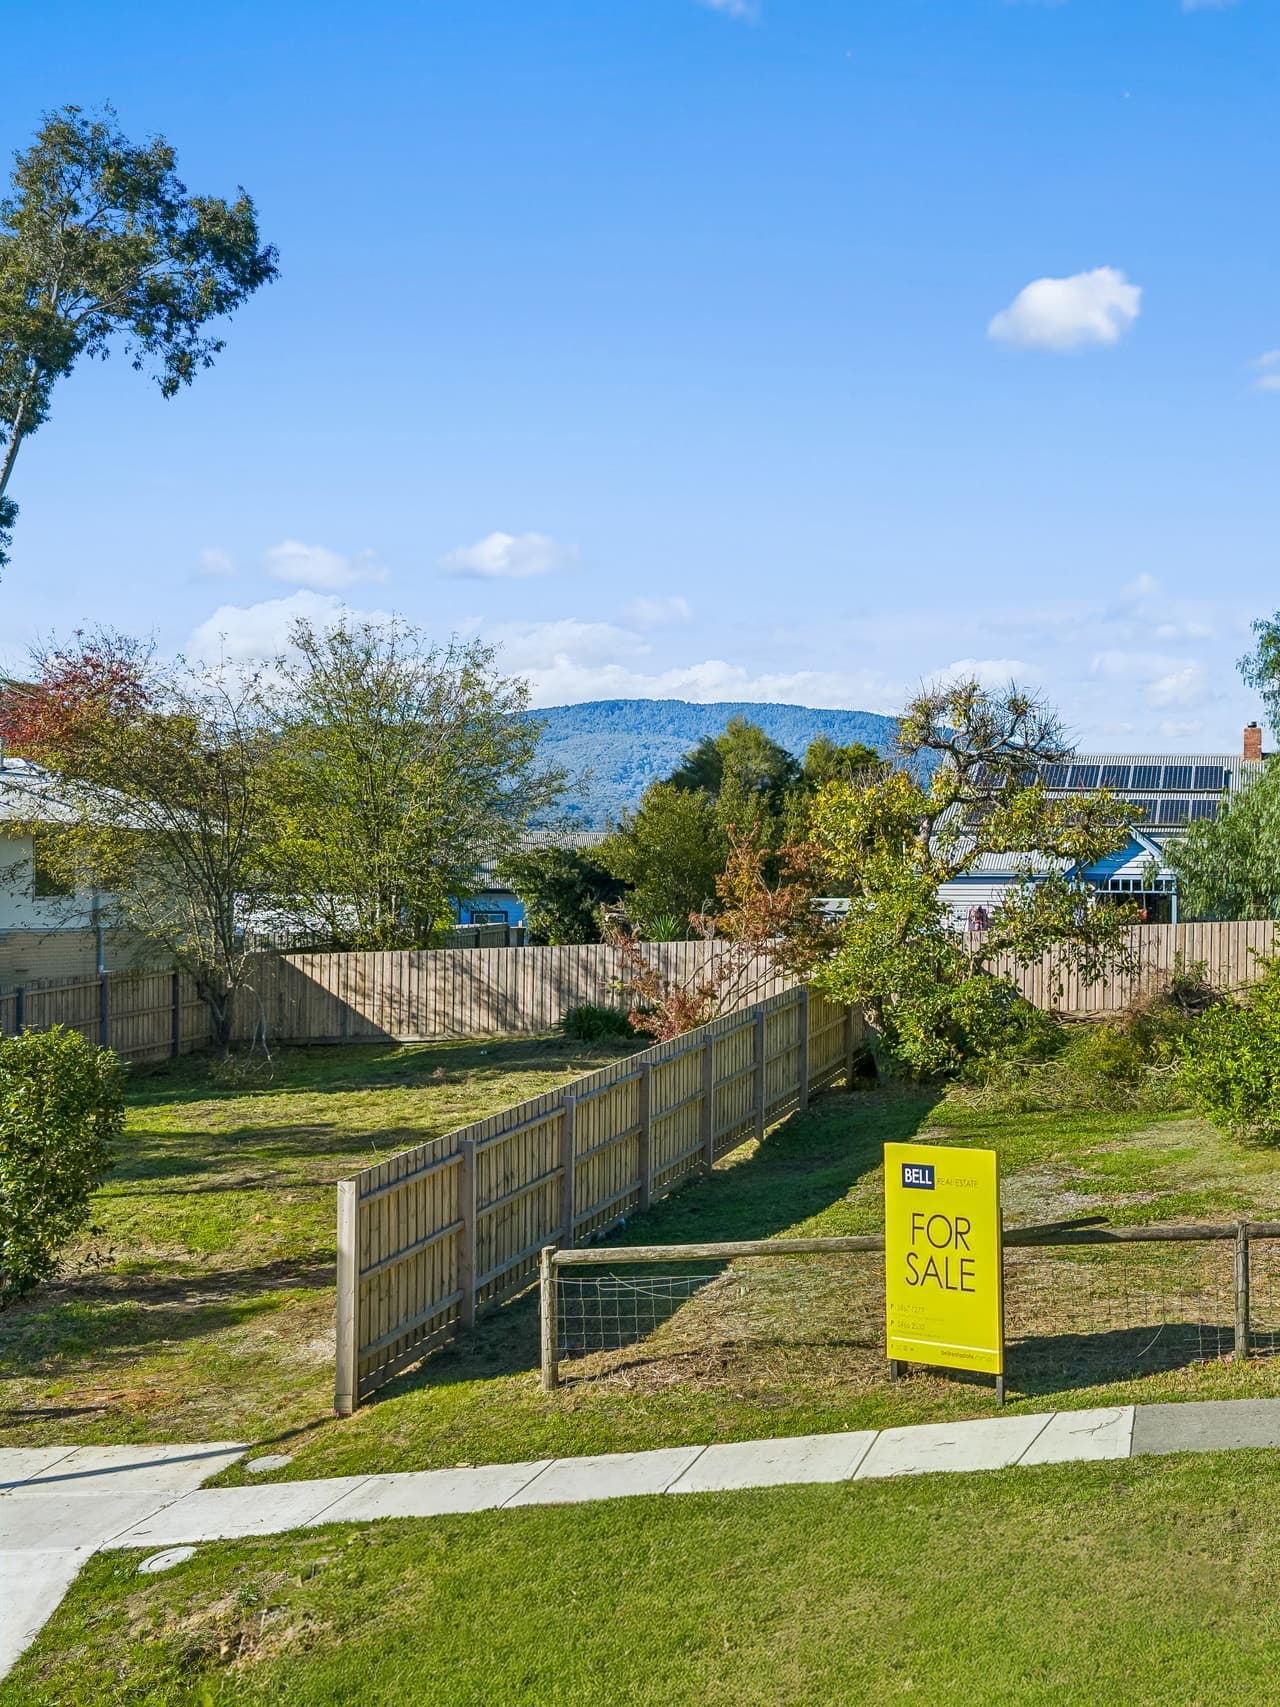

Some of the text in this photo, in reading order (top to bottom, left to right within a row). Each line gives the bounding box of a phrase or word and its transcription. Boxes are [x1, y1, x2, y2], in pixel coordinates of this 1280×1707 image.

[904, 1167, 978, 1188] BELL REAL ESTATE
[912, 1212, 971, 1251] FOR
[905, 1252, 975, 1292] SALE
